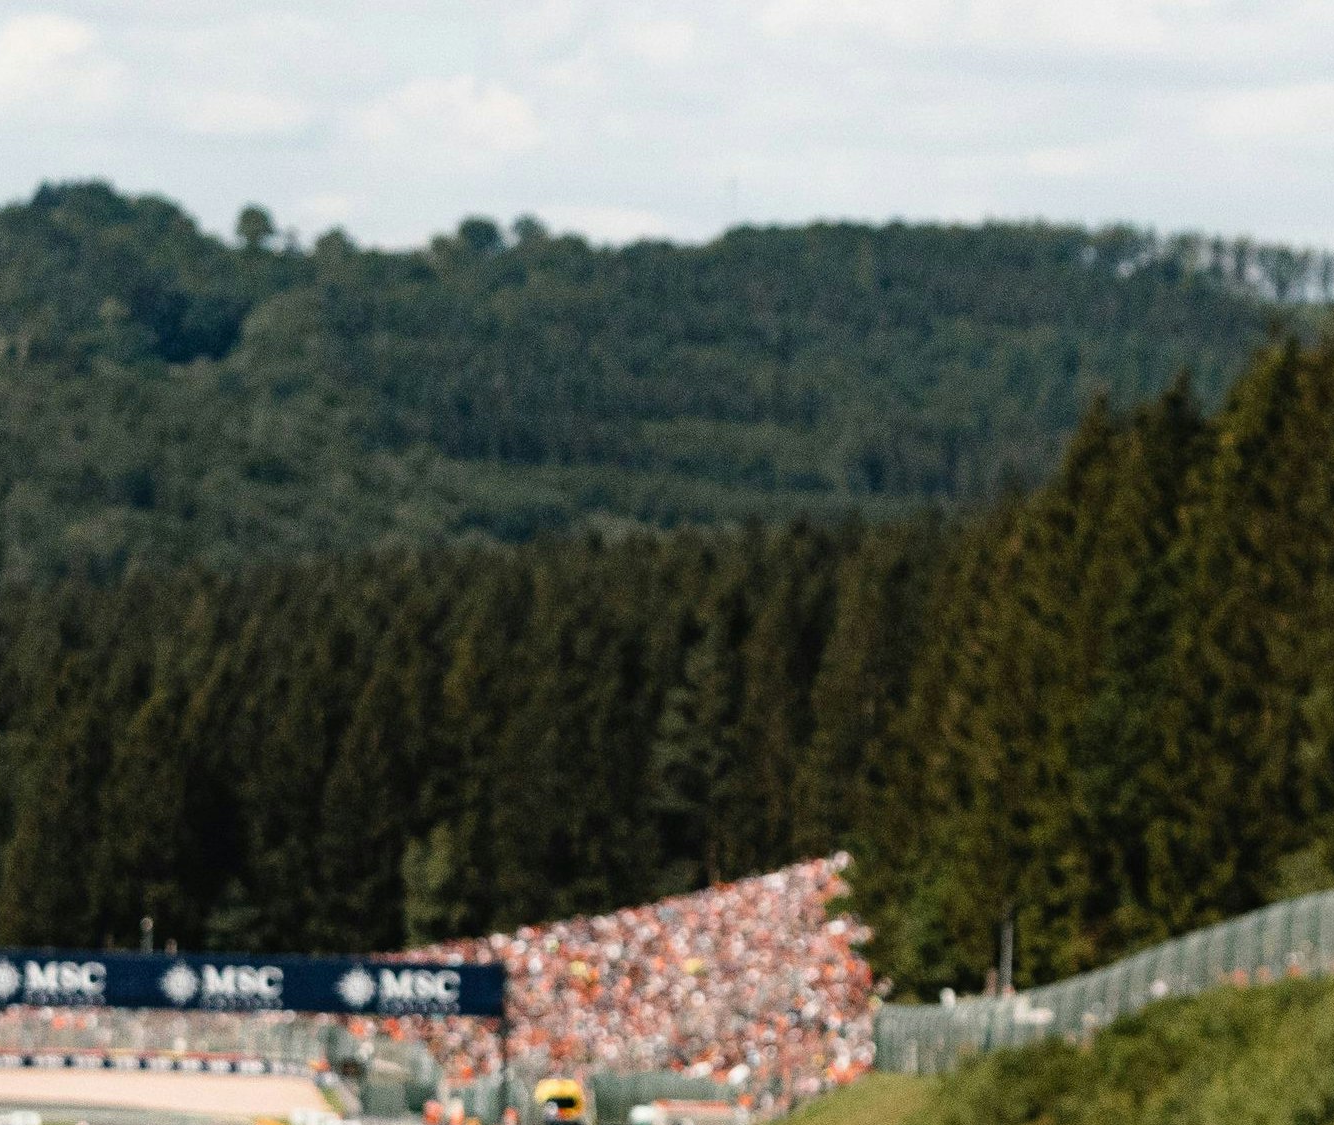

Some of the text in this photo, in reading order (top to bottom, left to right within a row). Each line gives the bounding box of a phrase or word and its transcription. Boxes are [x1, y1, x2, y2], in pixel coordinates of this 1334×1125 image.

[24, 960, 107, 995] MSC
[201, 964, 284, 999] MSC
[379, 968, 462, 1002] MSC
